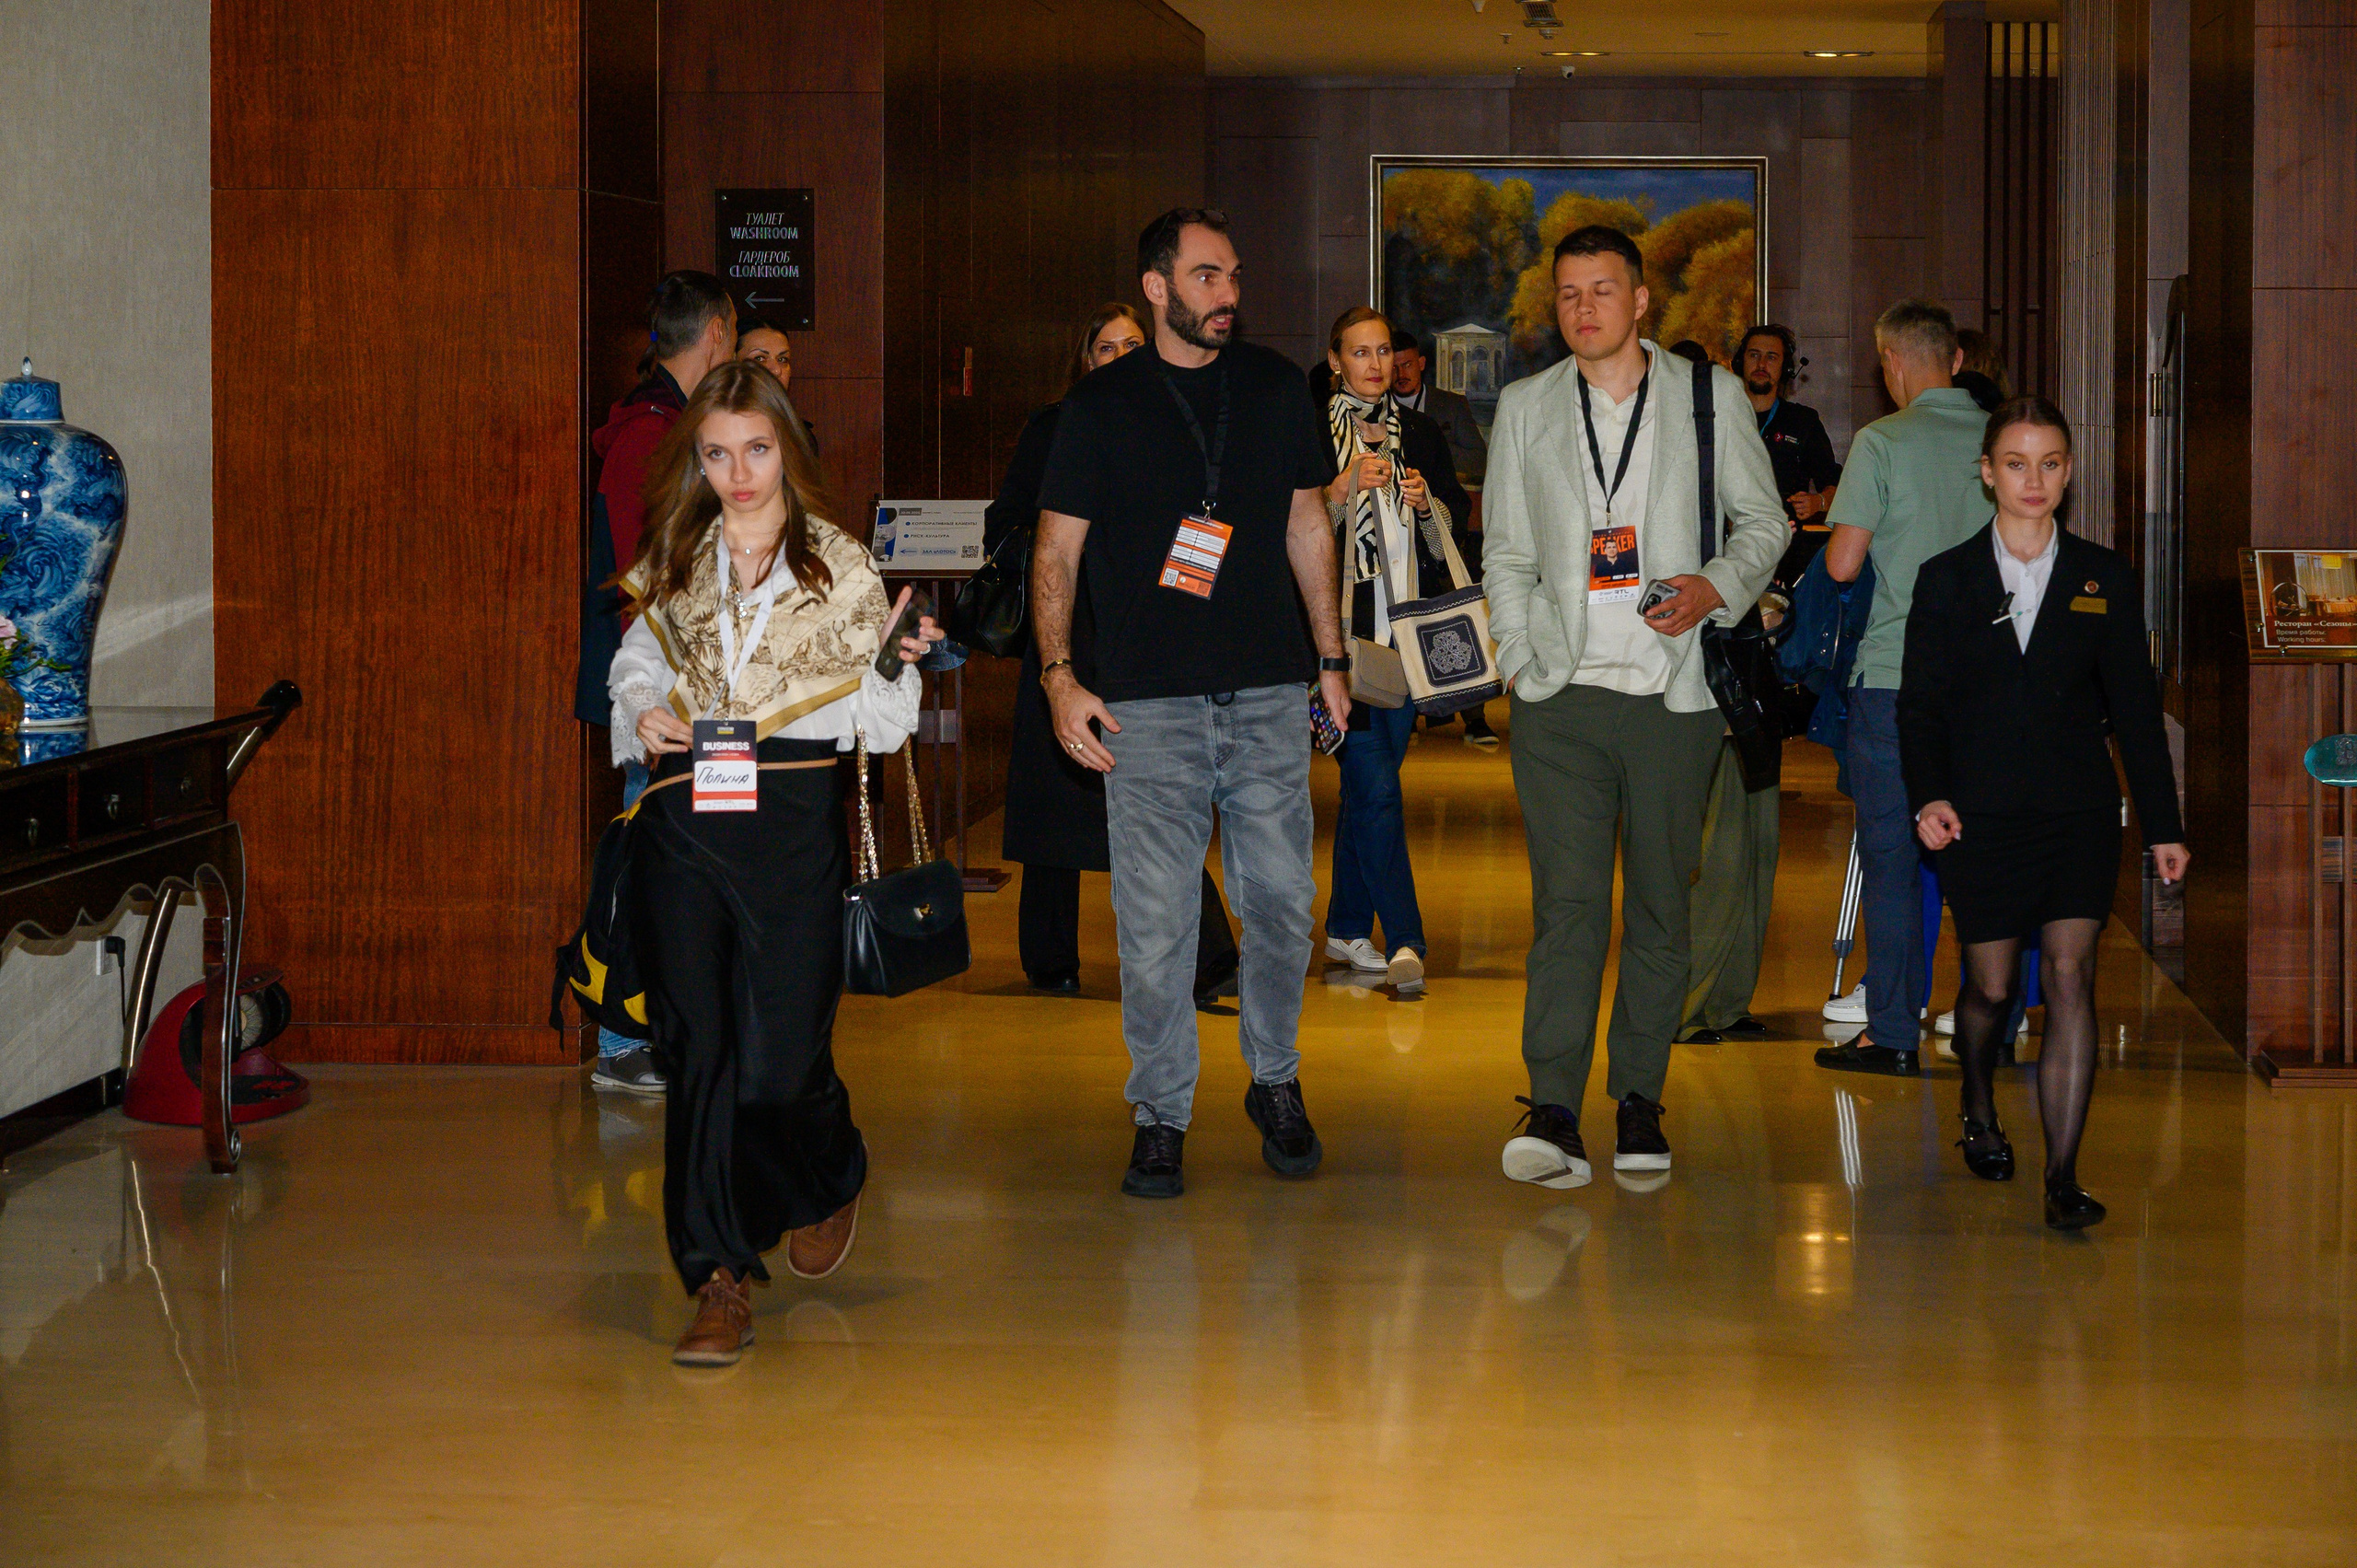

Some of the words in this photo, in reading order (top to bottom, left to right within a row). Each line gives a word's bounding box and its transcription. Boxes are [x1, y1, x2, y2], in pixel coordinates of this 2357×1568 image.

[746, 212, 784, 226] ТУАЛЕТ
[729, 226, 799, 239] WASHROOM
[738, 250, 791, 265] ГАРДЕРОБ
[729, 265, 799, 278] CLOAKROOM
[1590, 534, 1635, 555] PEKER
[2274, 620, 2312, 628] Ресторан
[702, 741, 750, 751] BUSINESS
[696, 766, 749, 784] Полина
